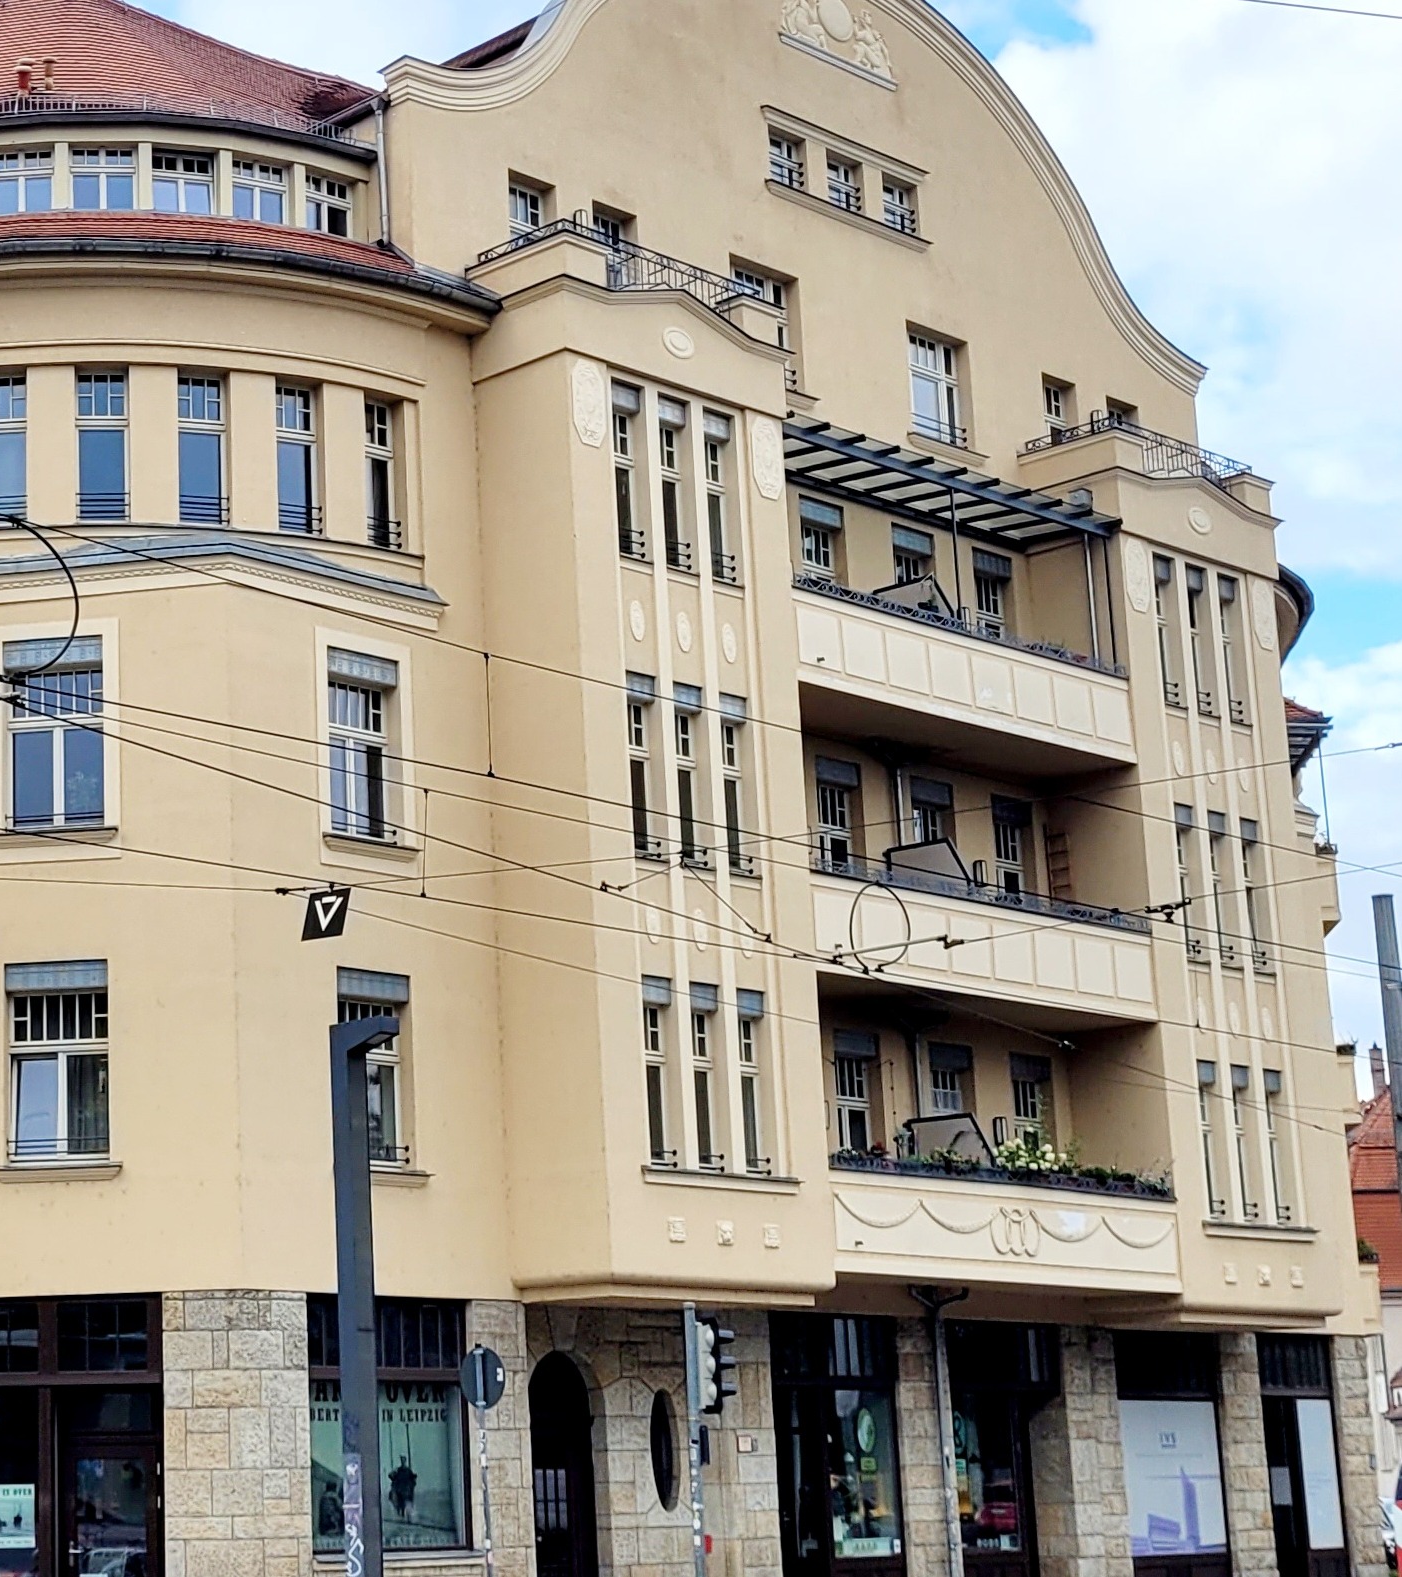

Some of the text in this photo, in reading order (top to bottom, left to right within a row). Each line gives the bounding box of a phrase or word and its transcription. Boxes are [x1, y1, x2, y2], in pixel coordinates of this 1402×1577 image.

[385, 1382, 445, 1403] OVER
[310, 1408, 447, 1422] BERT IN LEIPZIG
